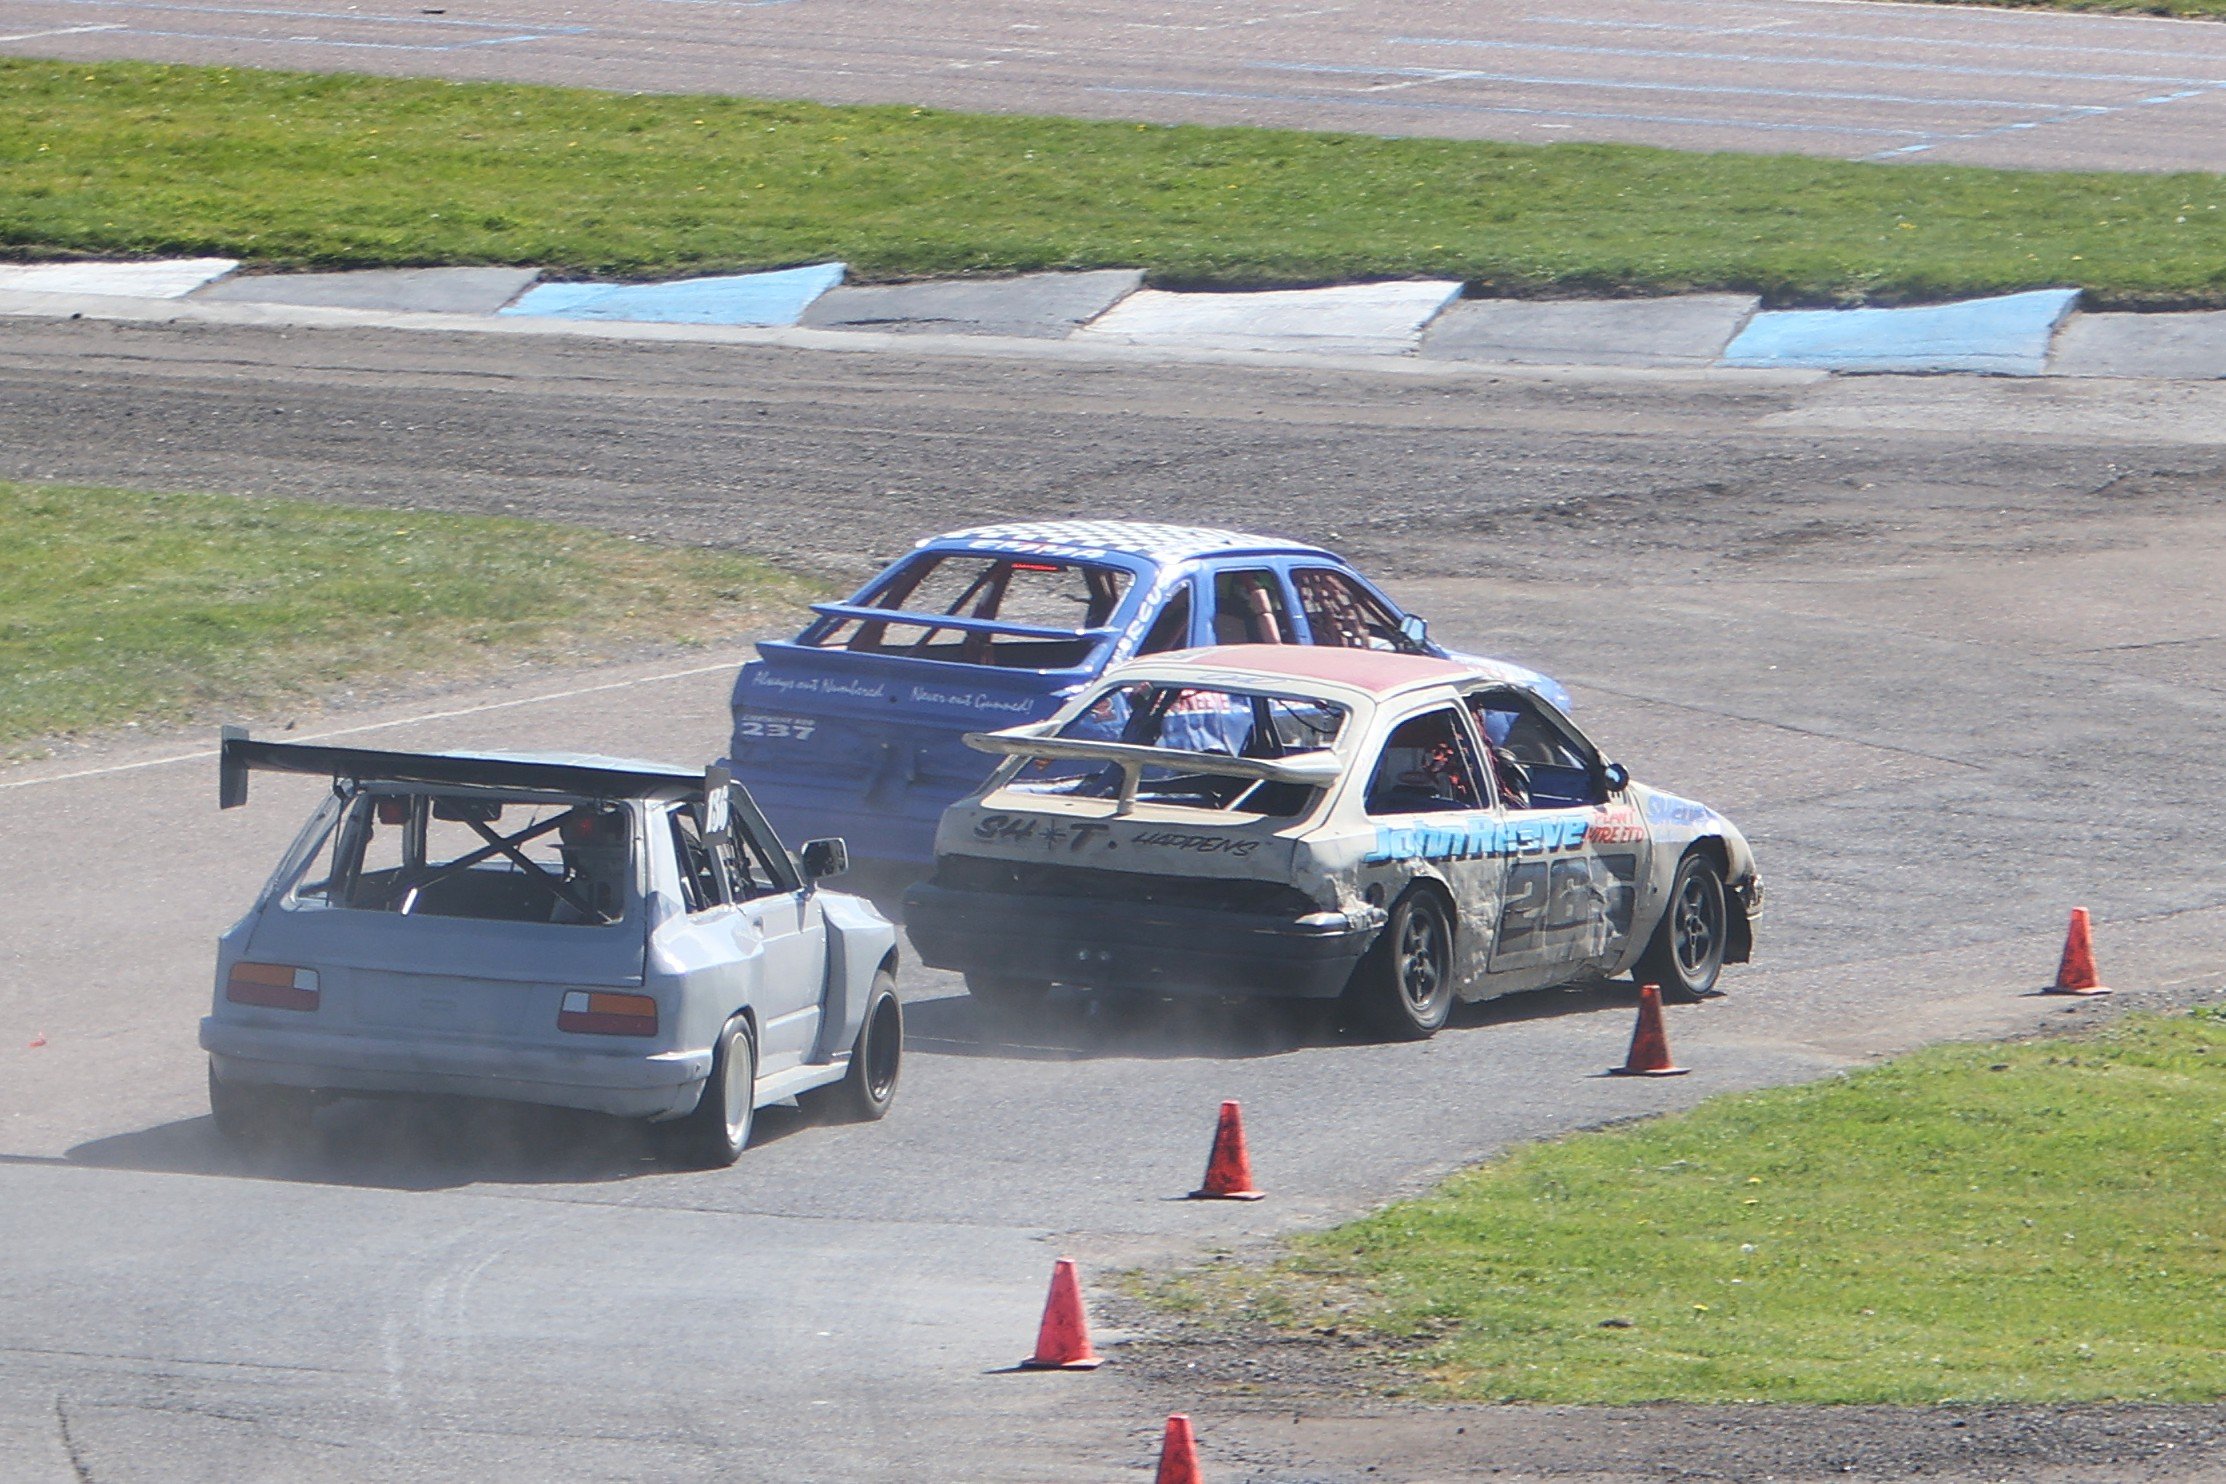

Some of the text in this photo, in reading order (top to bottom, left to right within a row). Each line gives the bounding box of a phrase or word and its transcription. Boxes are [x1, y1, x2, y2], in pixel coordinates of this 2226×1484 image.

[909, 686, 945, 703] Never
[742, 722, 816, 741] 237
[1131, 831, 1260, 857] HAPPENS
